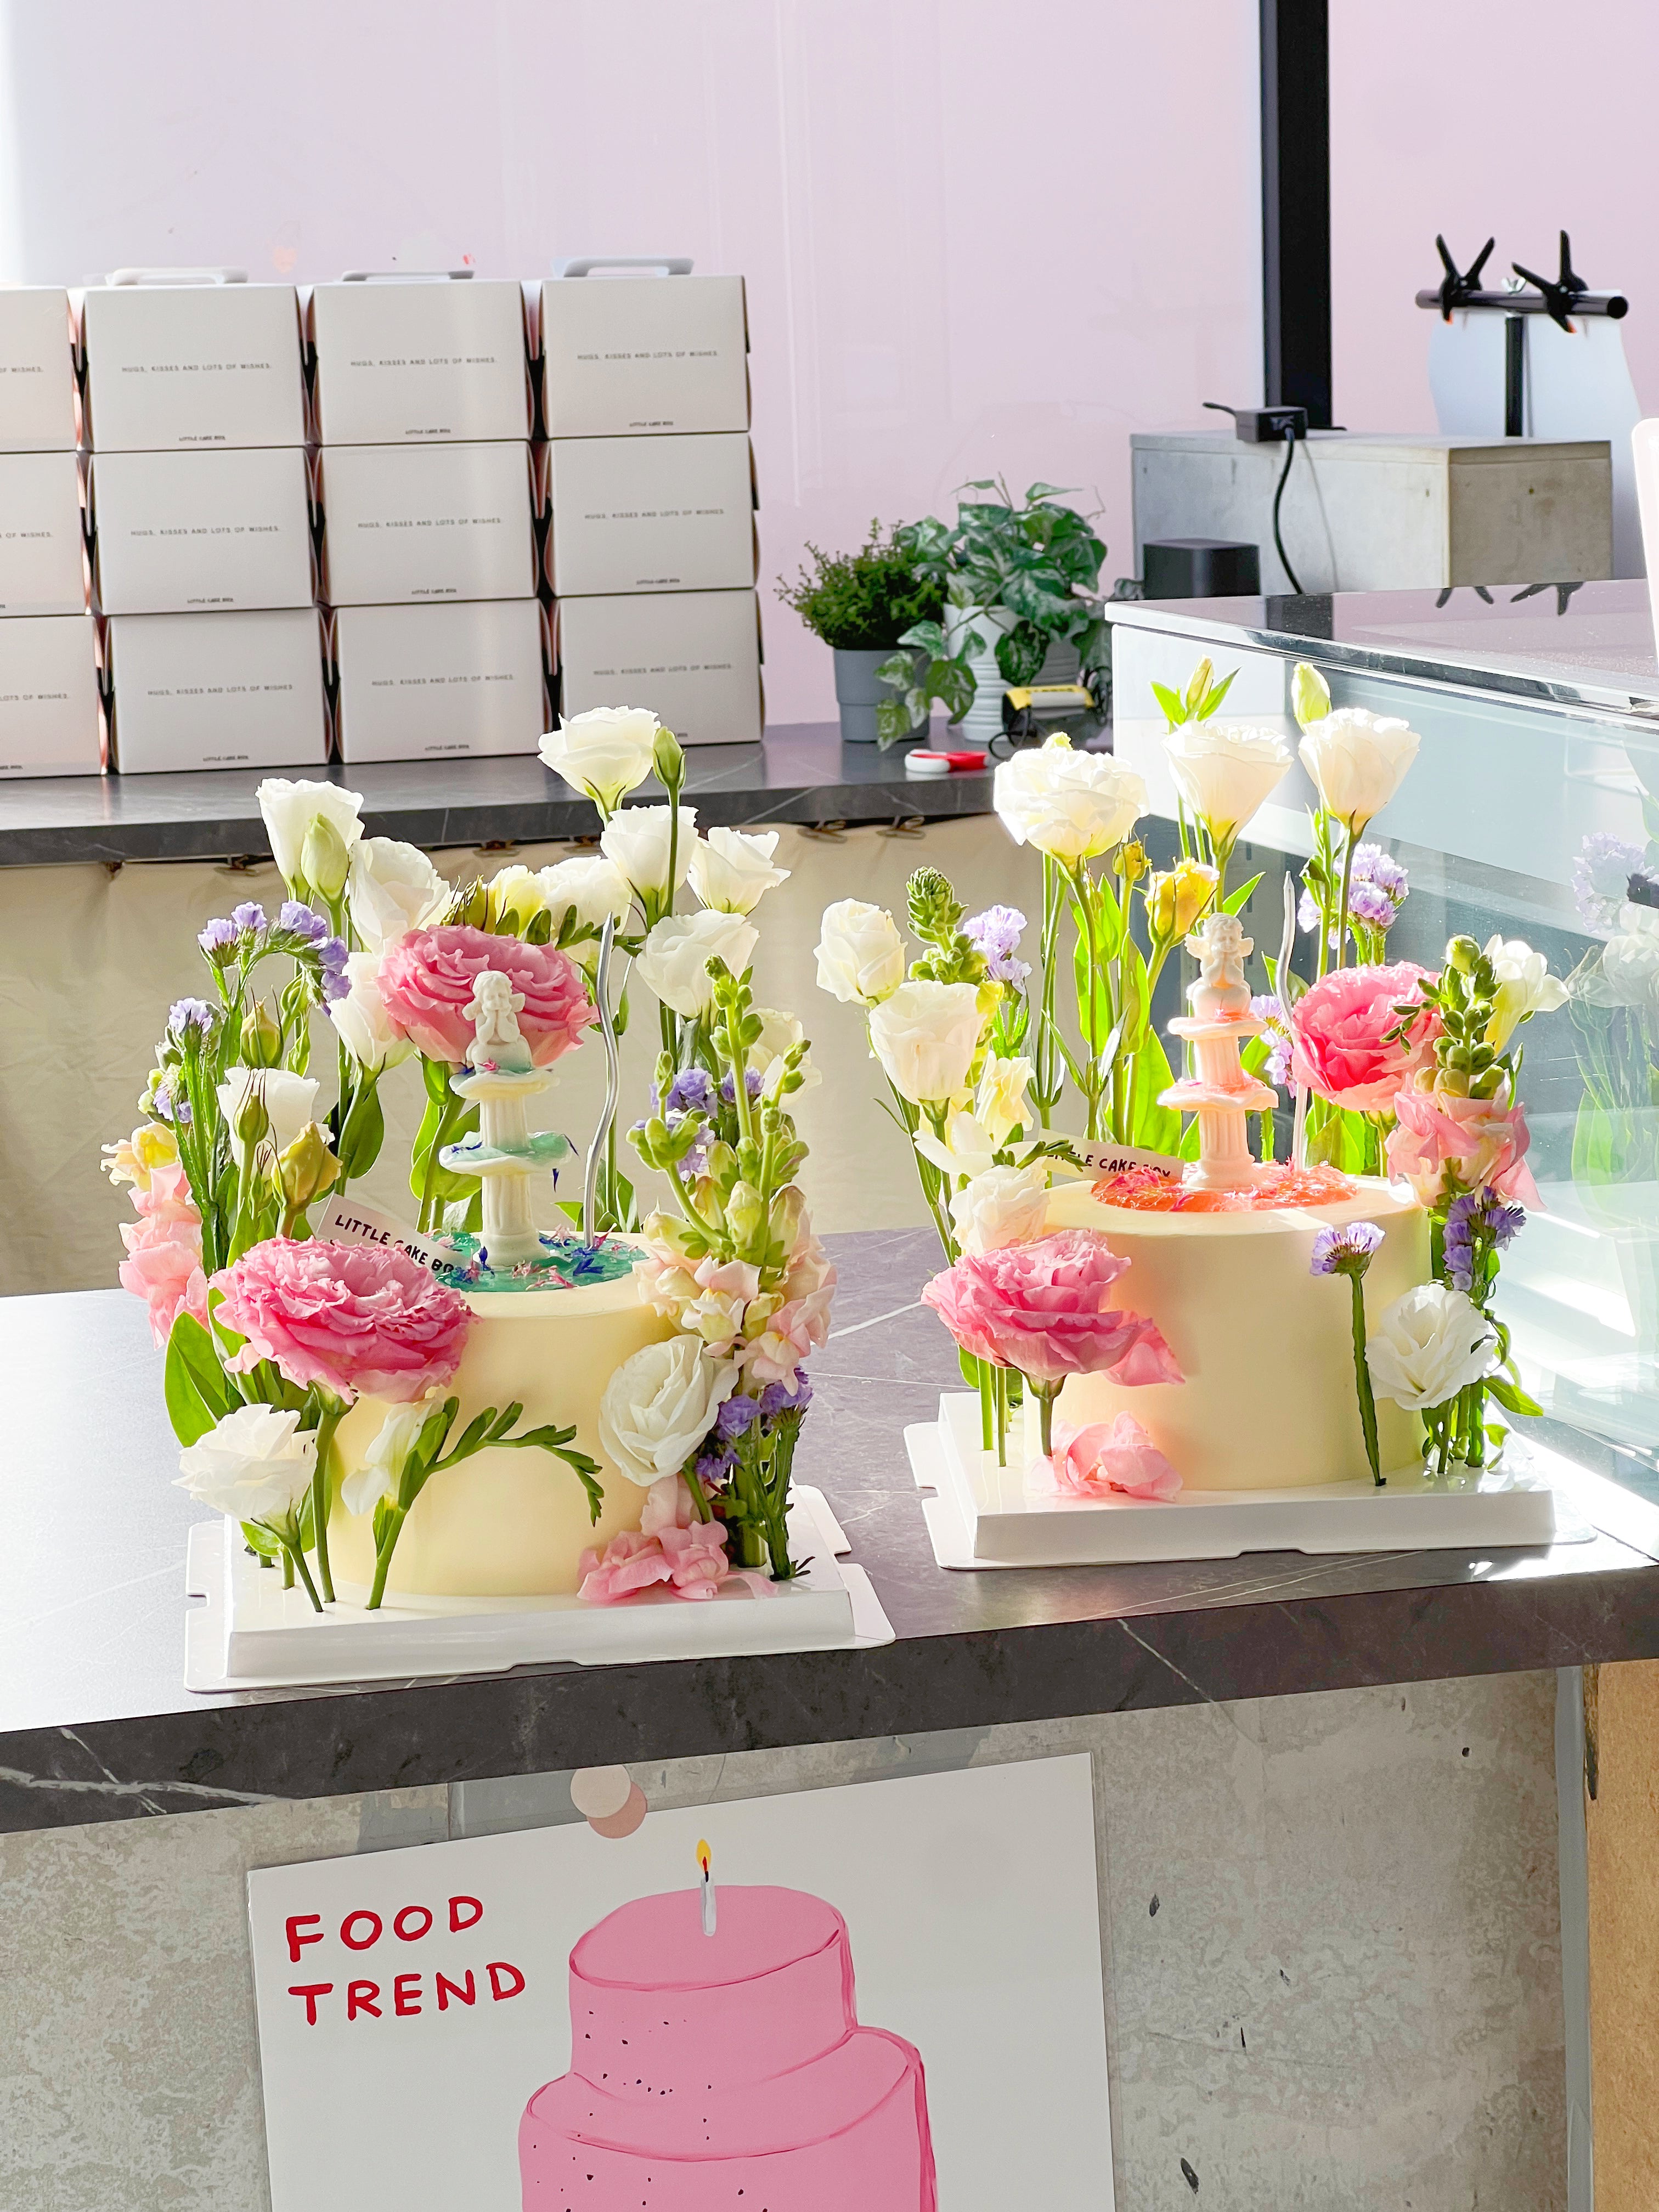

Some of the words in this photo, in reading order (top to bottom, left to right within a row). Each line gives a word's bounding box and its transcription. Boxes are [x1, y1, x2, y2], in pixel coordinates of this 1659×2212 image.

[335, 1215, 391, 1245] LITTLE
[394, 1240, 428, 1265] AKE
[286, 1895, 483, 1963] FOOD
[288, 1962, 526, 2026] TREND
